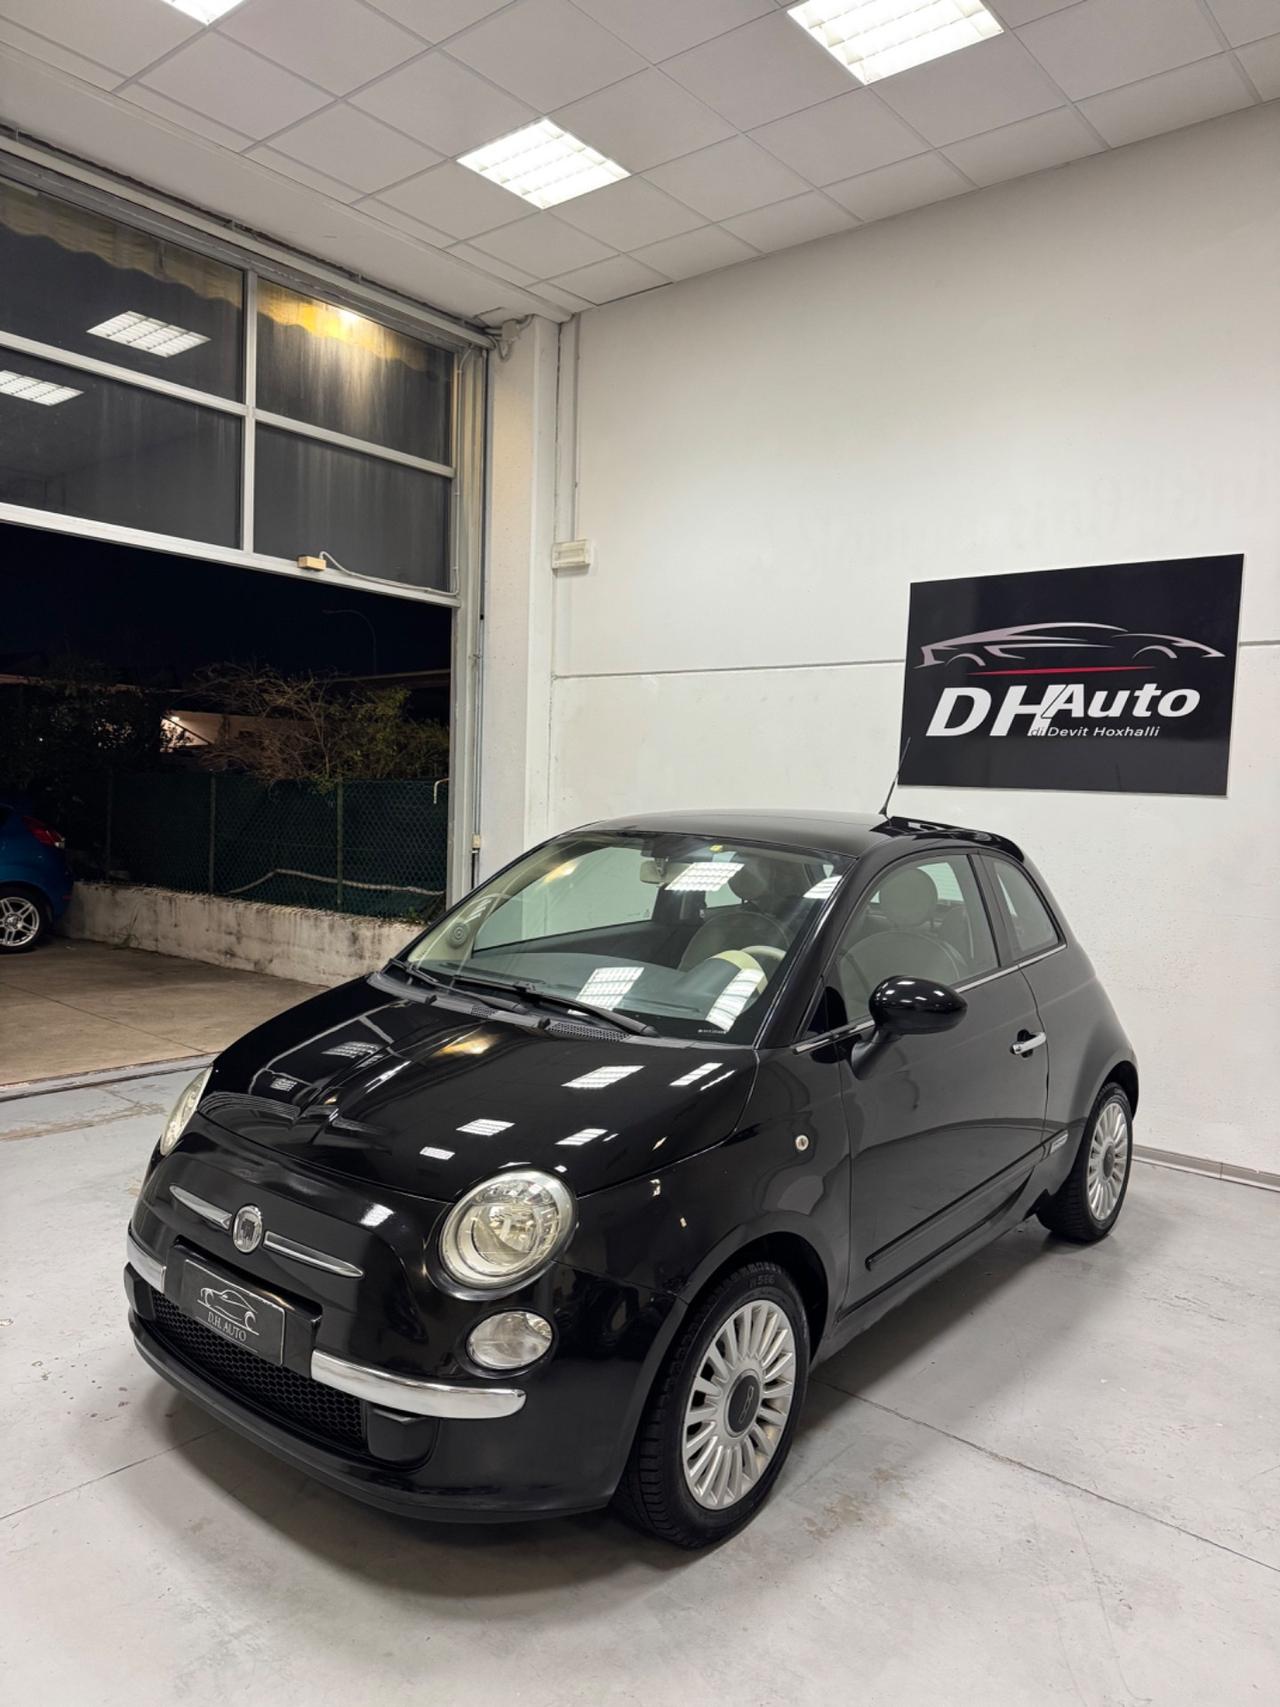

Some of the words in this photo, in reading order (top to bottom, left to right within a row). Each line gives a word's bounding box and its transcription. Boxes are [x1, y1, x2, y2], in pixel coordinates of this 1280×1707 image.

[1047, 726, 1089, 737] Devit
[1093, 726, 1160, 737] Hoxhalli
[222, 1321, 247, 1342] AUTO
